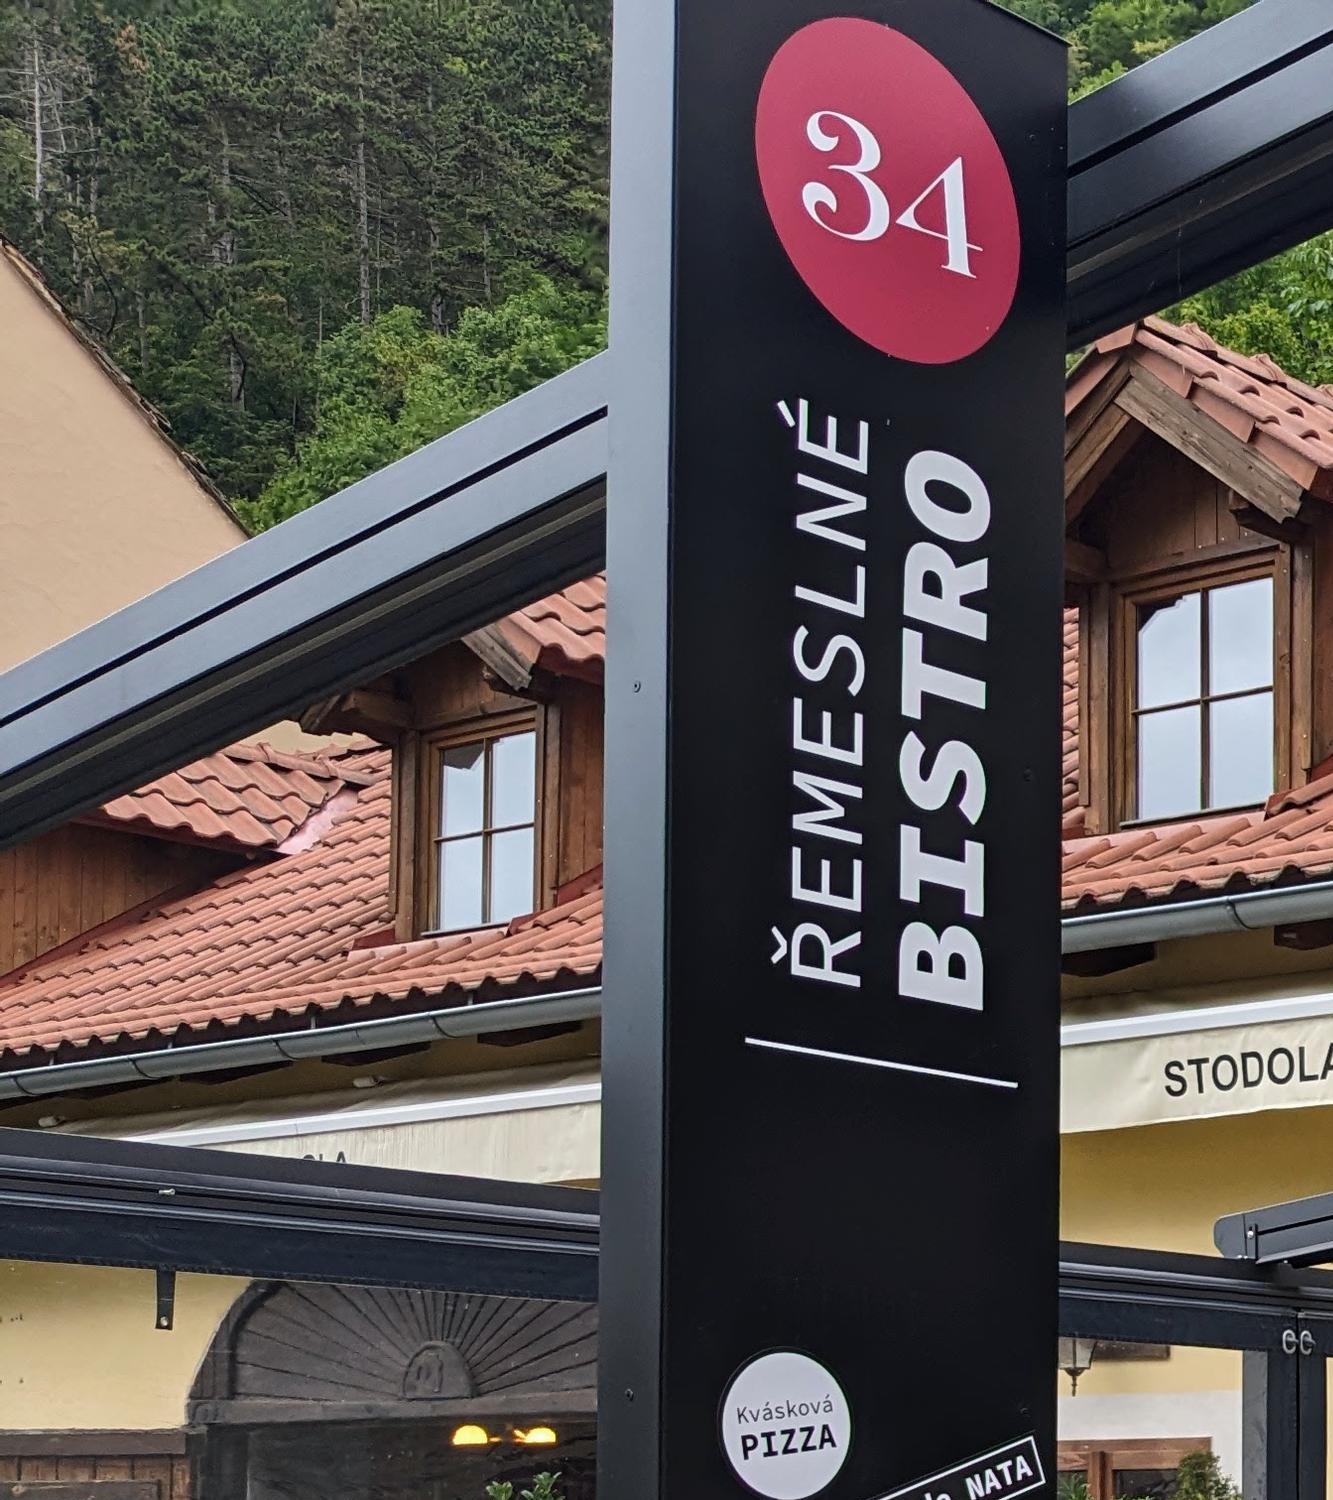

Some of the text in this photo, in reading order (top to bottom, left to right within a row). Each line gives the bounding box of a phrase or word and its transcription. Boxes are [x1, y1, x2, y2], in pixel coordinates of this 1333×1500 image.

[802, 111, 982, 278] 34
[771, 399, 868, 987] ŘEMESLNÉ
[899, 450, 990, 1010] BISTRO
[736, 1393, 834, 1424] Kvásková
[740, 1423, 837, 1461] PIZZA
[965, 1454, 1034, 1500] NATA
